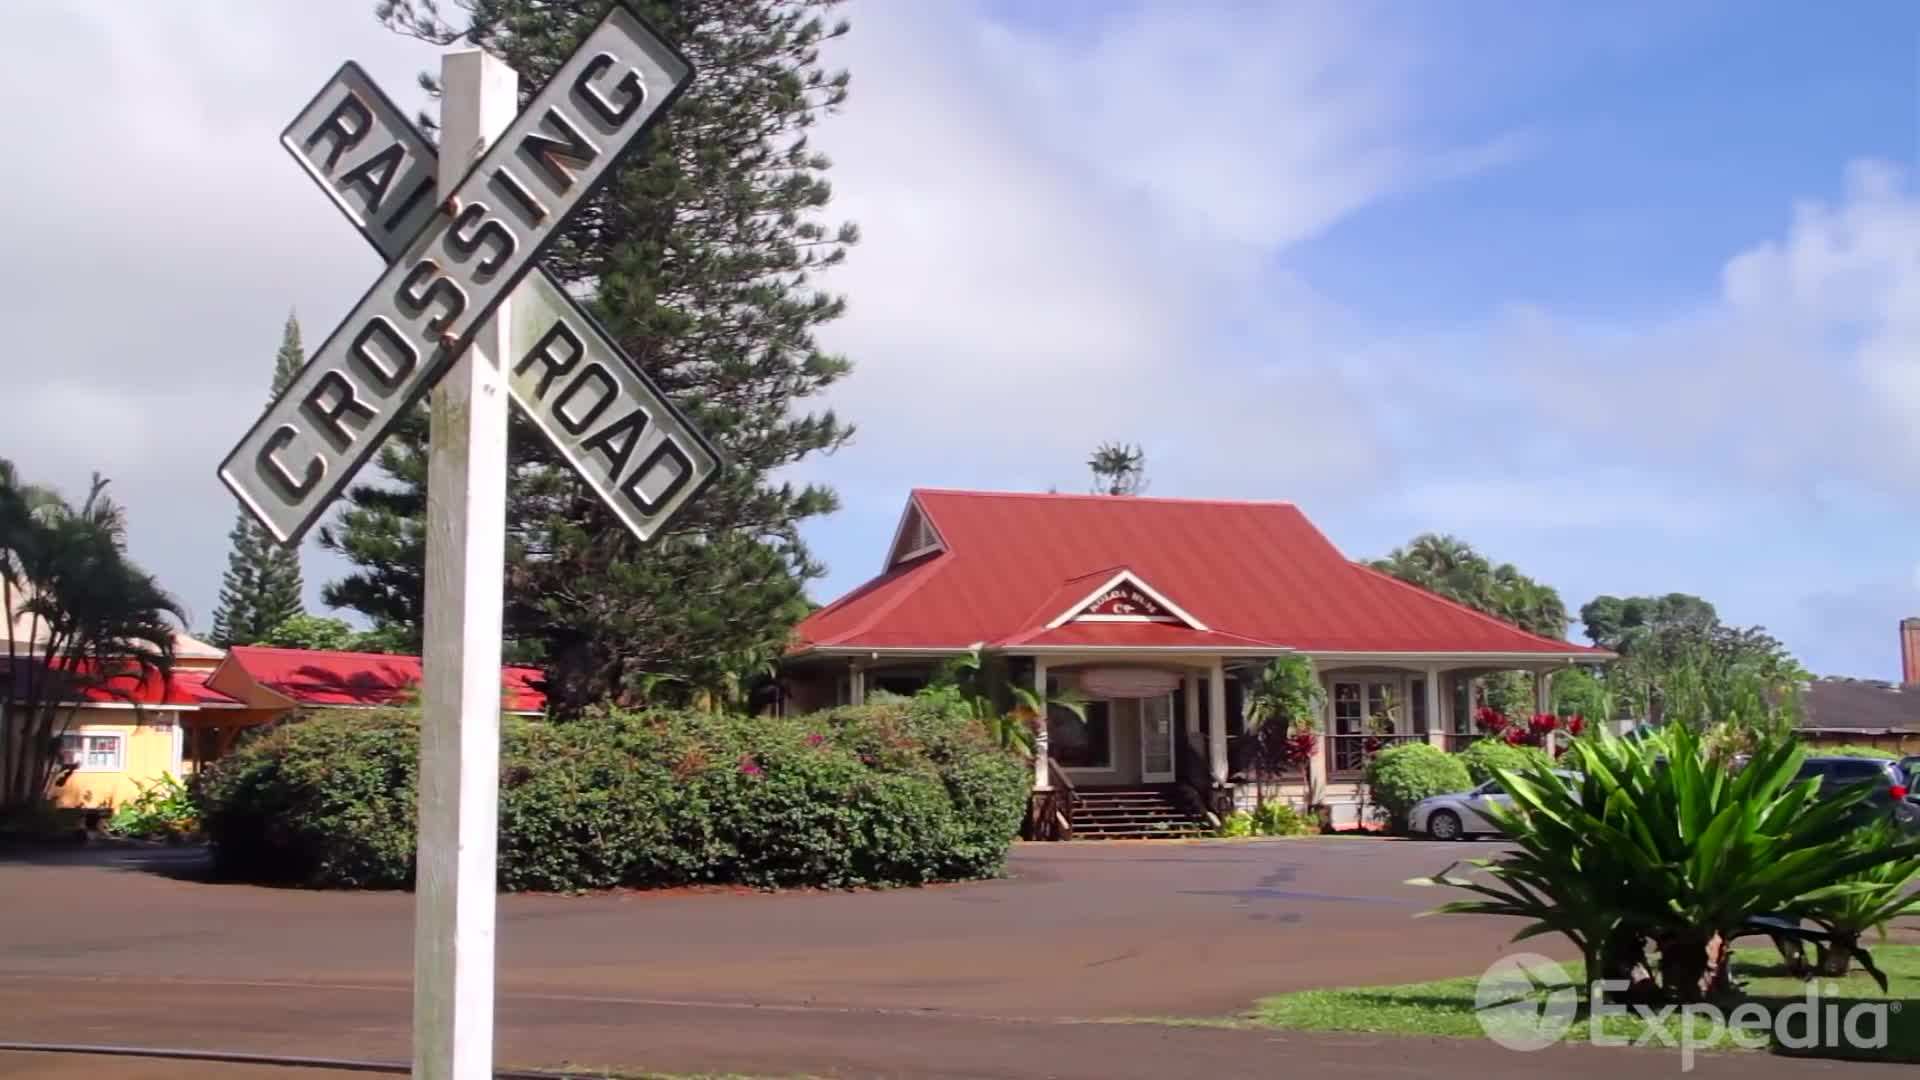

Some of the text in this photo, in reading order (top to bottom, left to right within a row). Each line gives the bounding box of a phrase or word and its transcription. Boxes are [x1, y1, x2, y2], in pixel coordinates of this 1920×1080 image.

[257, 51, 648, 506] CROSSING
[305, 90, 695, 517] RAI ROAD
